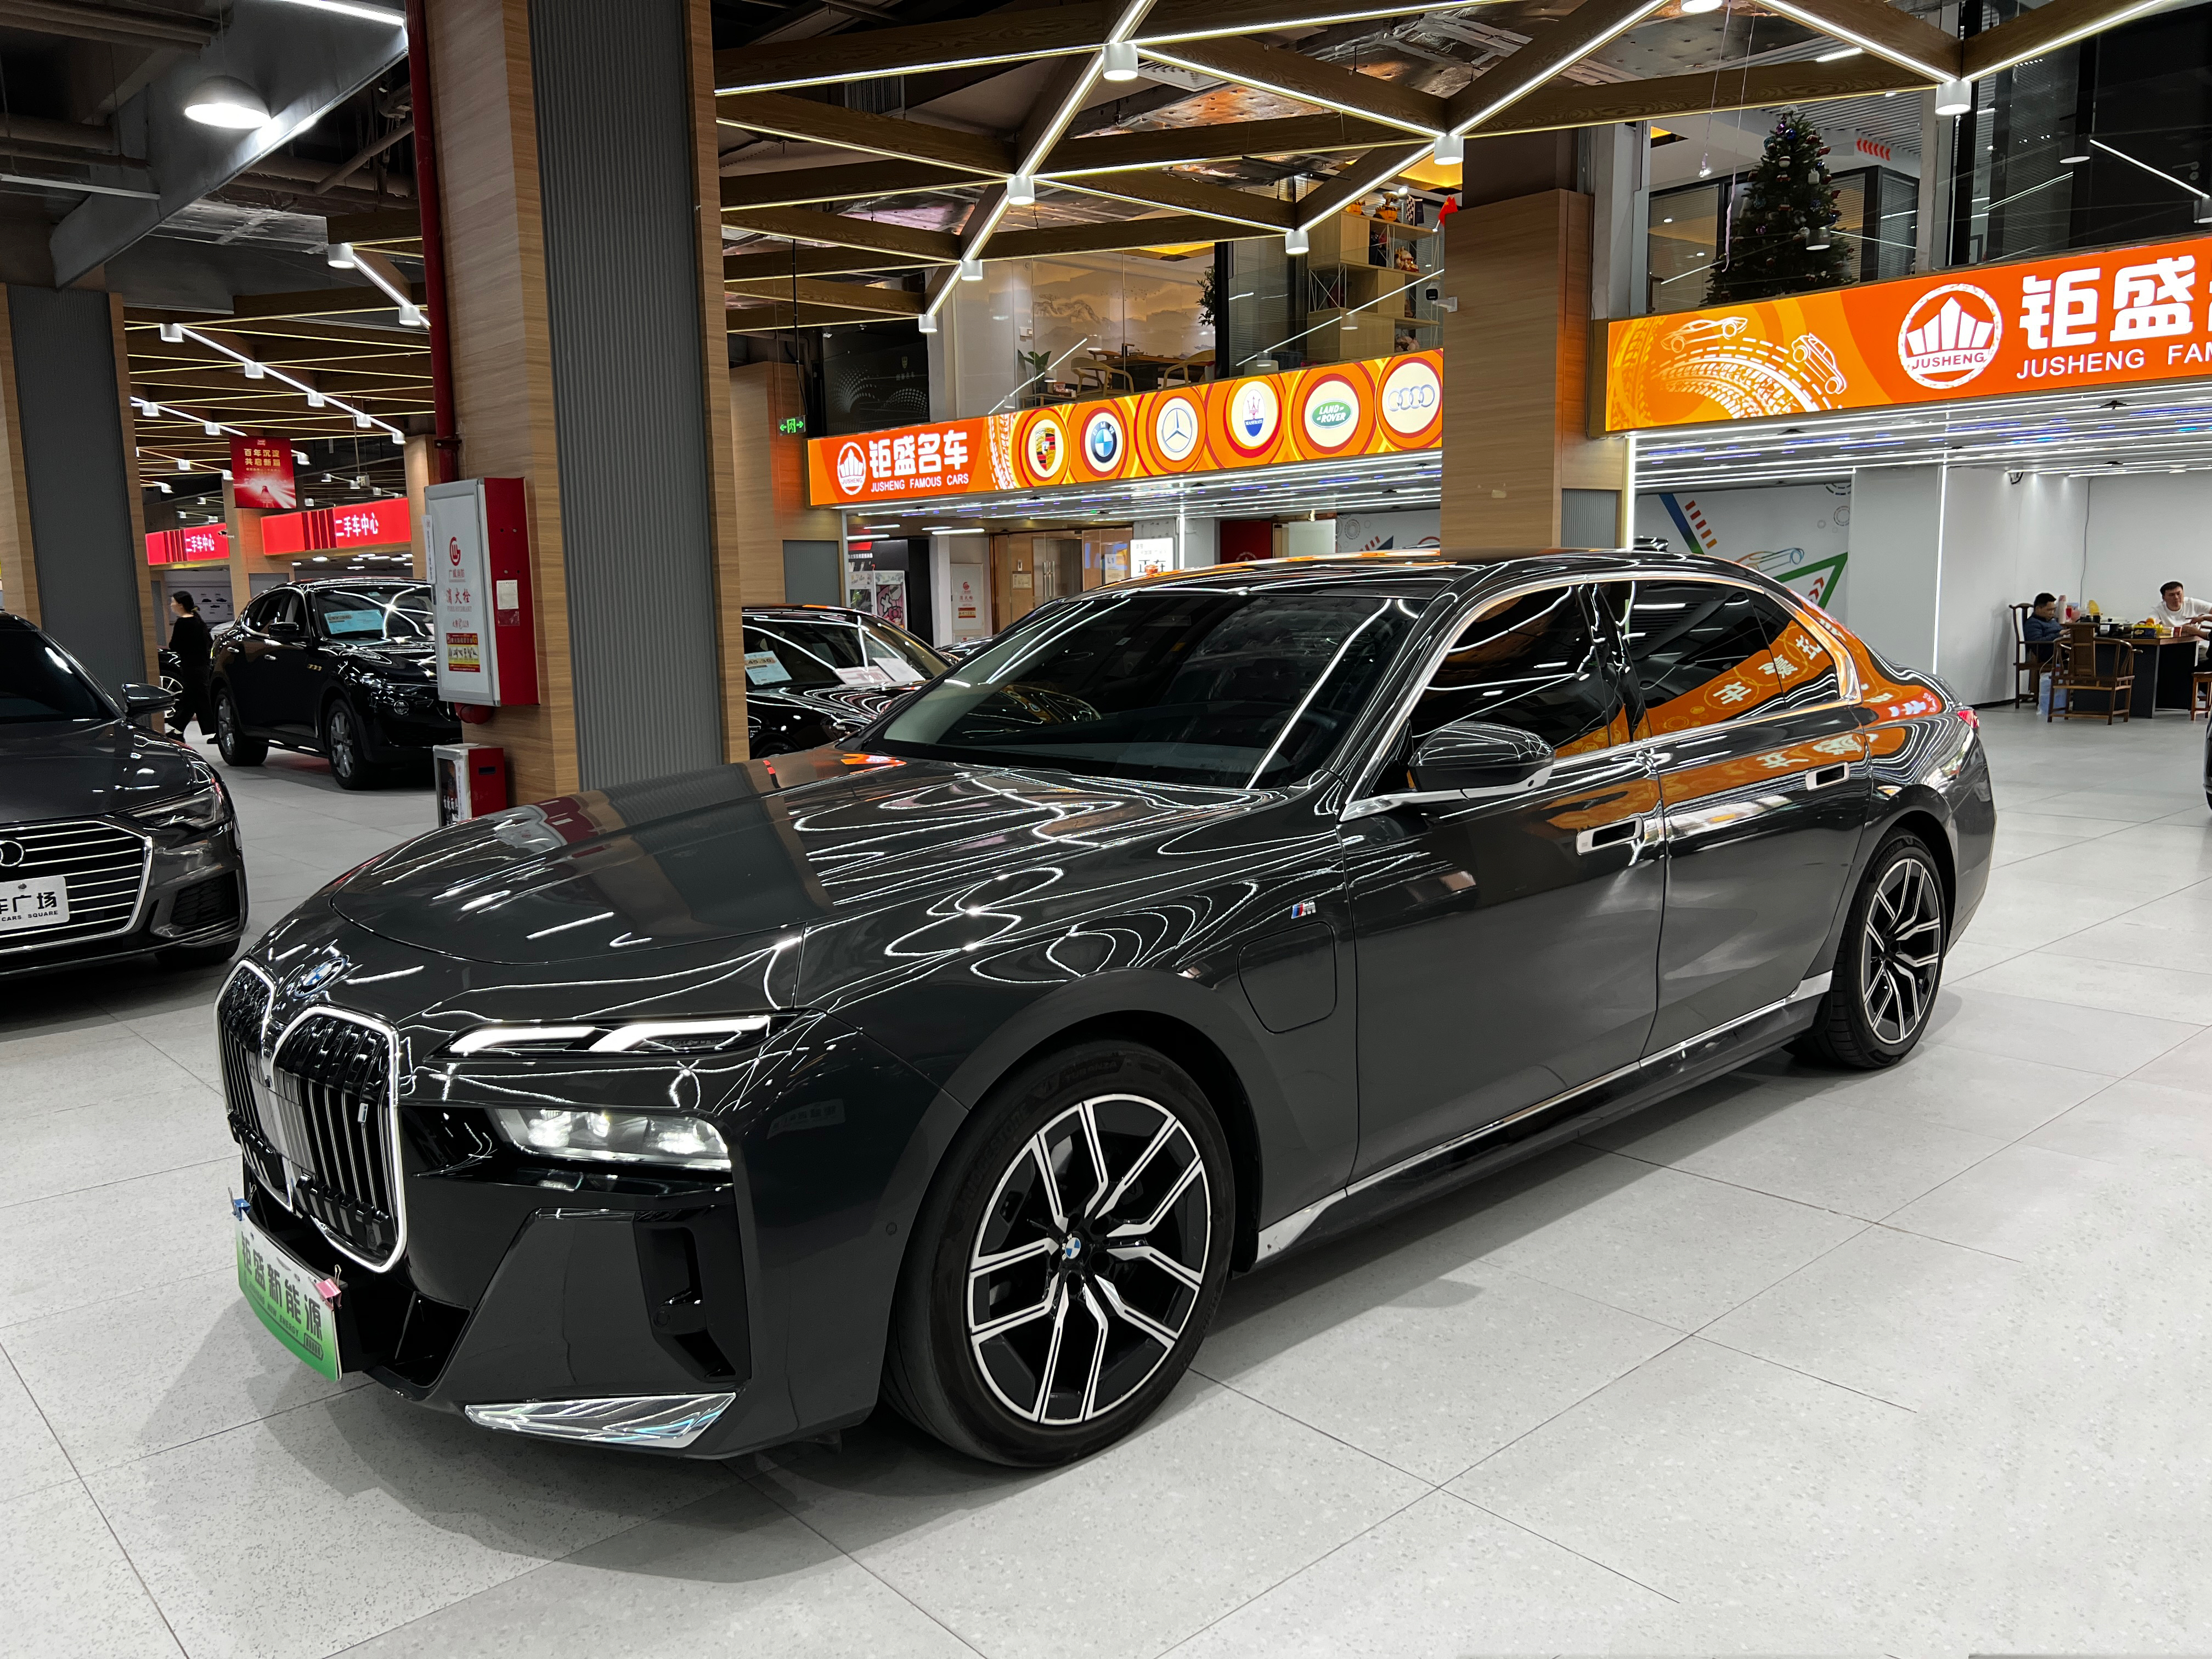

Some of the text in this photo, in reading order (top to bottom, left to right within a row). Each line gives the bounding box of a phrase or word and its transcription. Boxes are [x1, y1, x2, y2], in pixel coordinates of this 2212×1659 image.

[2019, 255, 2212, 349] 钜盛
[1911, 352, 1987, 370] JUSHENG
[2017, 348, 2145, 379] JUSHENG
[1319, 404, 1339, 414] LAND
[1321, 412, 1346, 423] ROVER
[1092, 421, 1115, 436] BMW
[868, 429, 968, 478] 钜盛名车
[871, 473, 969, 493] JUSHENG FAMOUS CARS
[335, 512, 379, 537] 二手车中心
[185, 534, 215, 552] 二手车中心
[28, 910, 59, 918] SQUARE
[241, 1231, 323, 1341] 钜盛新能源
[279, 1314, 299, 1338] ENERGY
